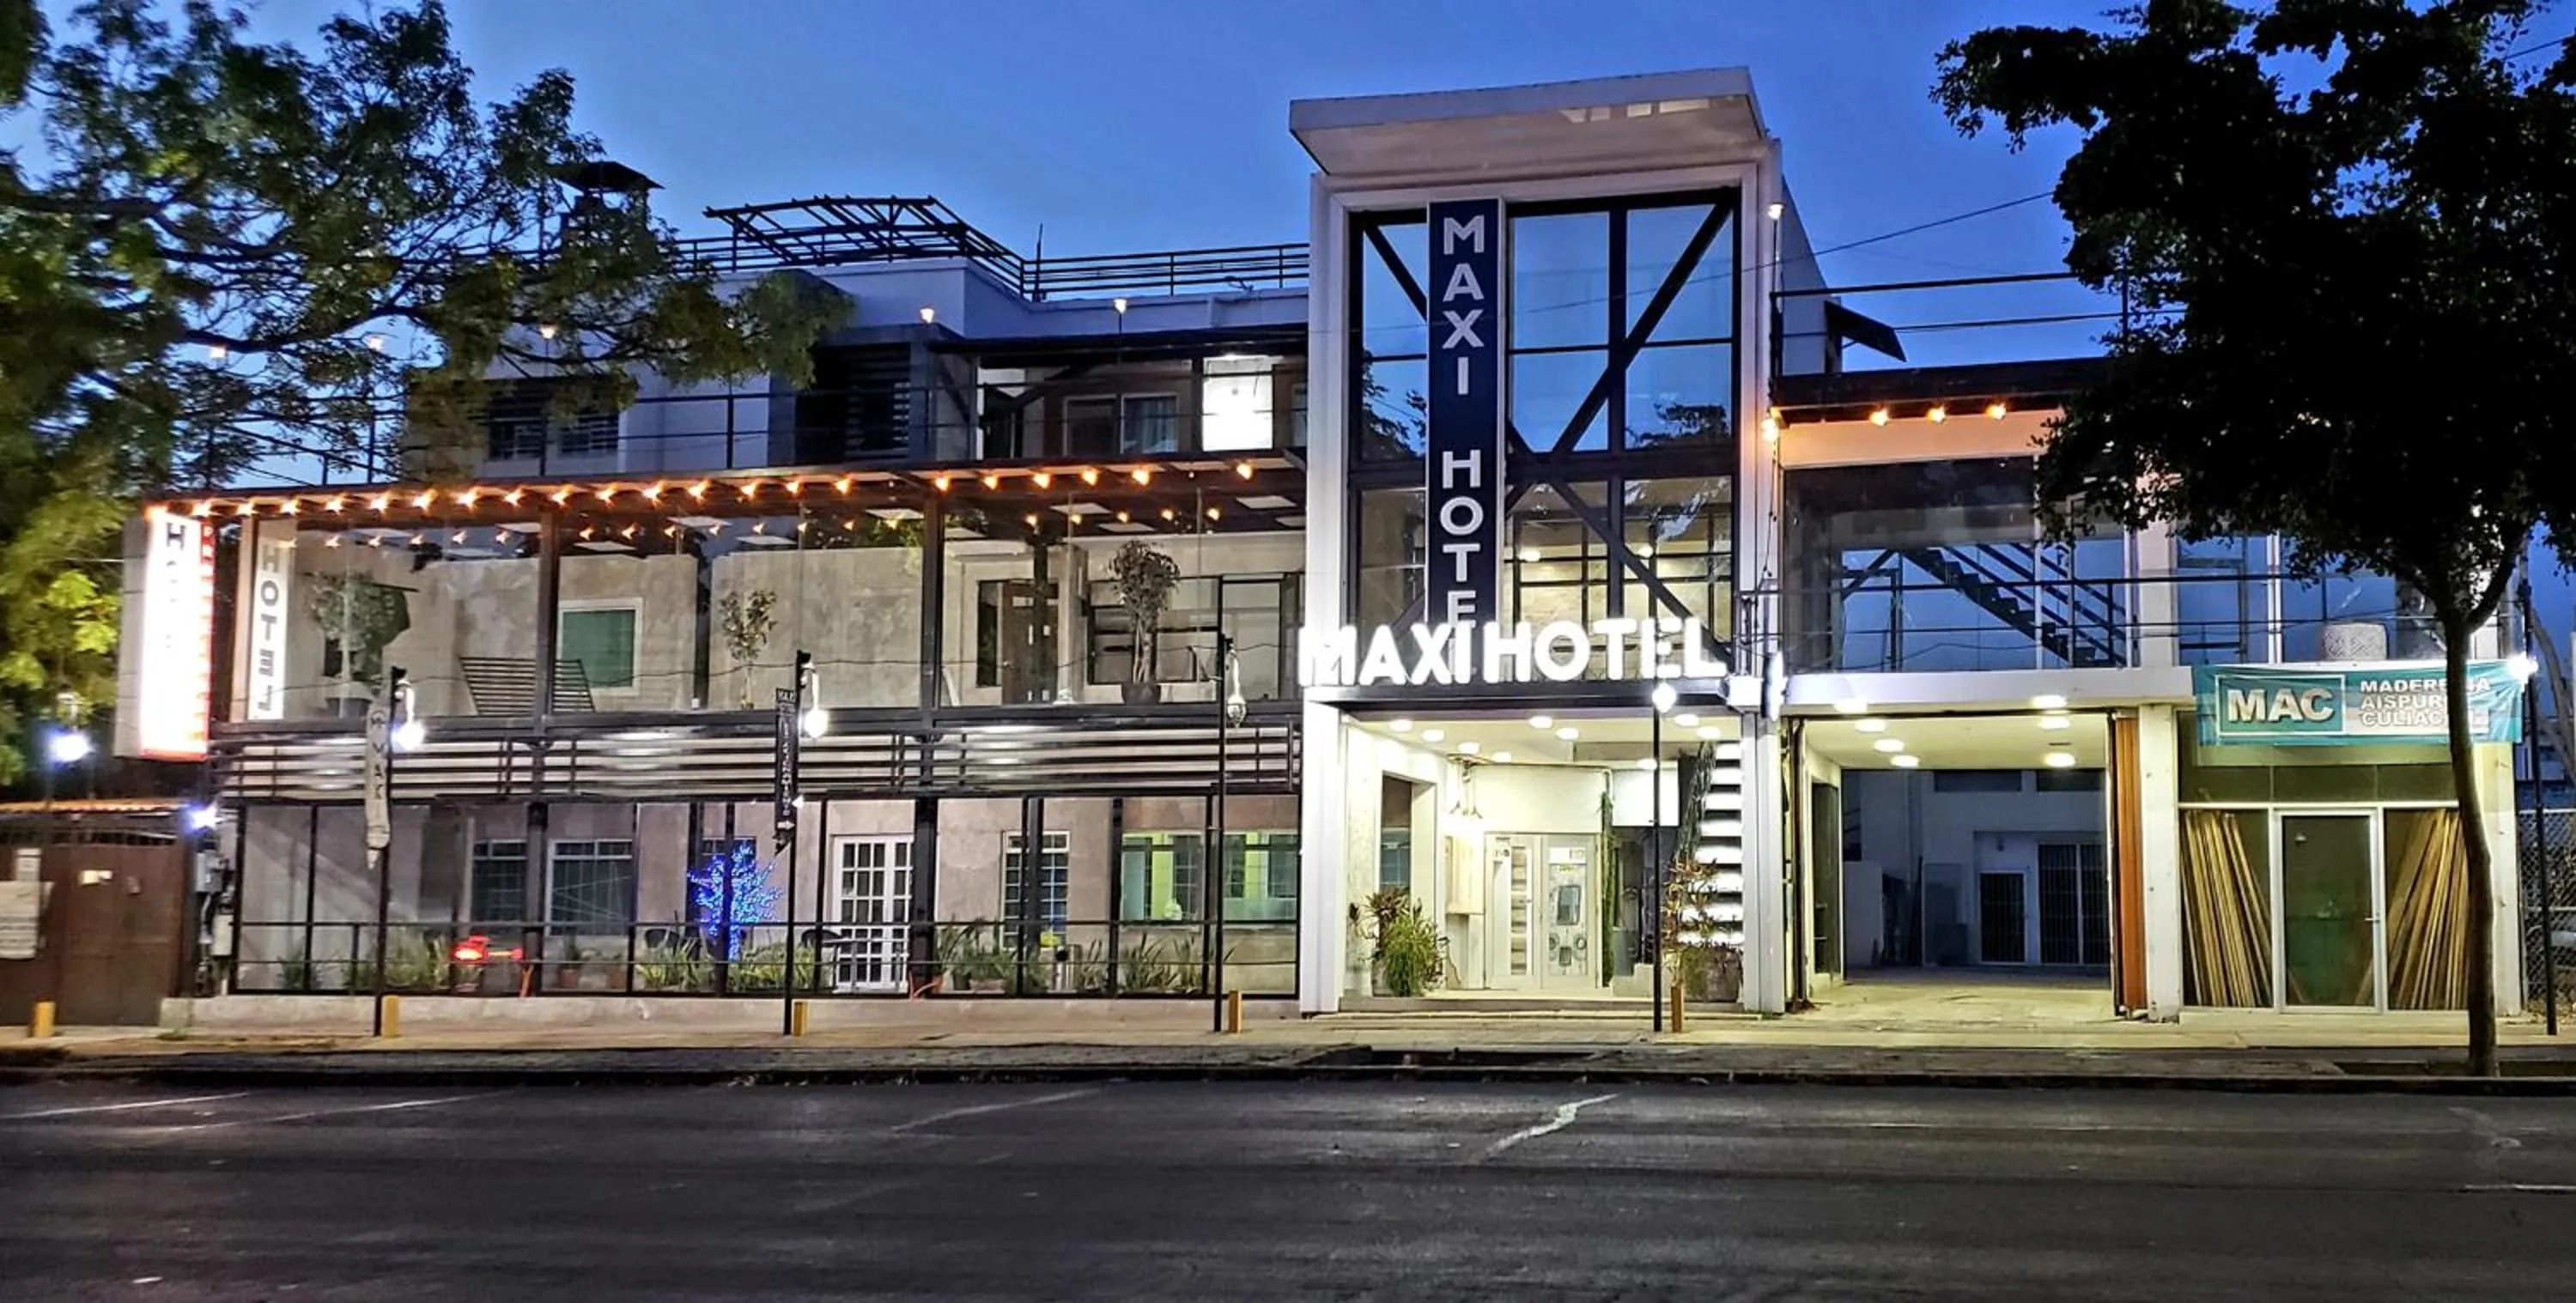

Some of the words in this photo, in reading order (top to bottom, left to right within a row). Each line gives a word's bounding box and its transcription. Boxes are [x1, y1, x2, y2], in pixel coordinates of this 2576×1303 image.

[1442, 214, 1485, 397] MAXI
[257, 542, 280, 712] HOTEL
[1297, 621, 1471, 687] MAXI
[1481, 617, 1727, 682] HOTEL
[2360, 677, 2491, 693] MADEREIA
[2361, 694, 2449, 710] AISPUR
[2227, 688, 2334, 722] MAC
[2362, 710, 2451, 726] CULIAC
